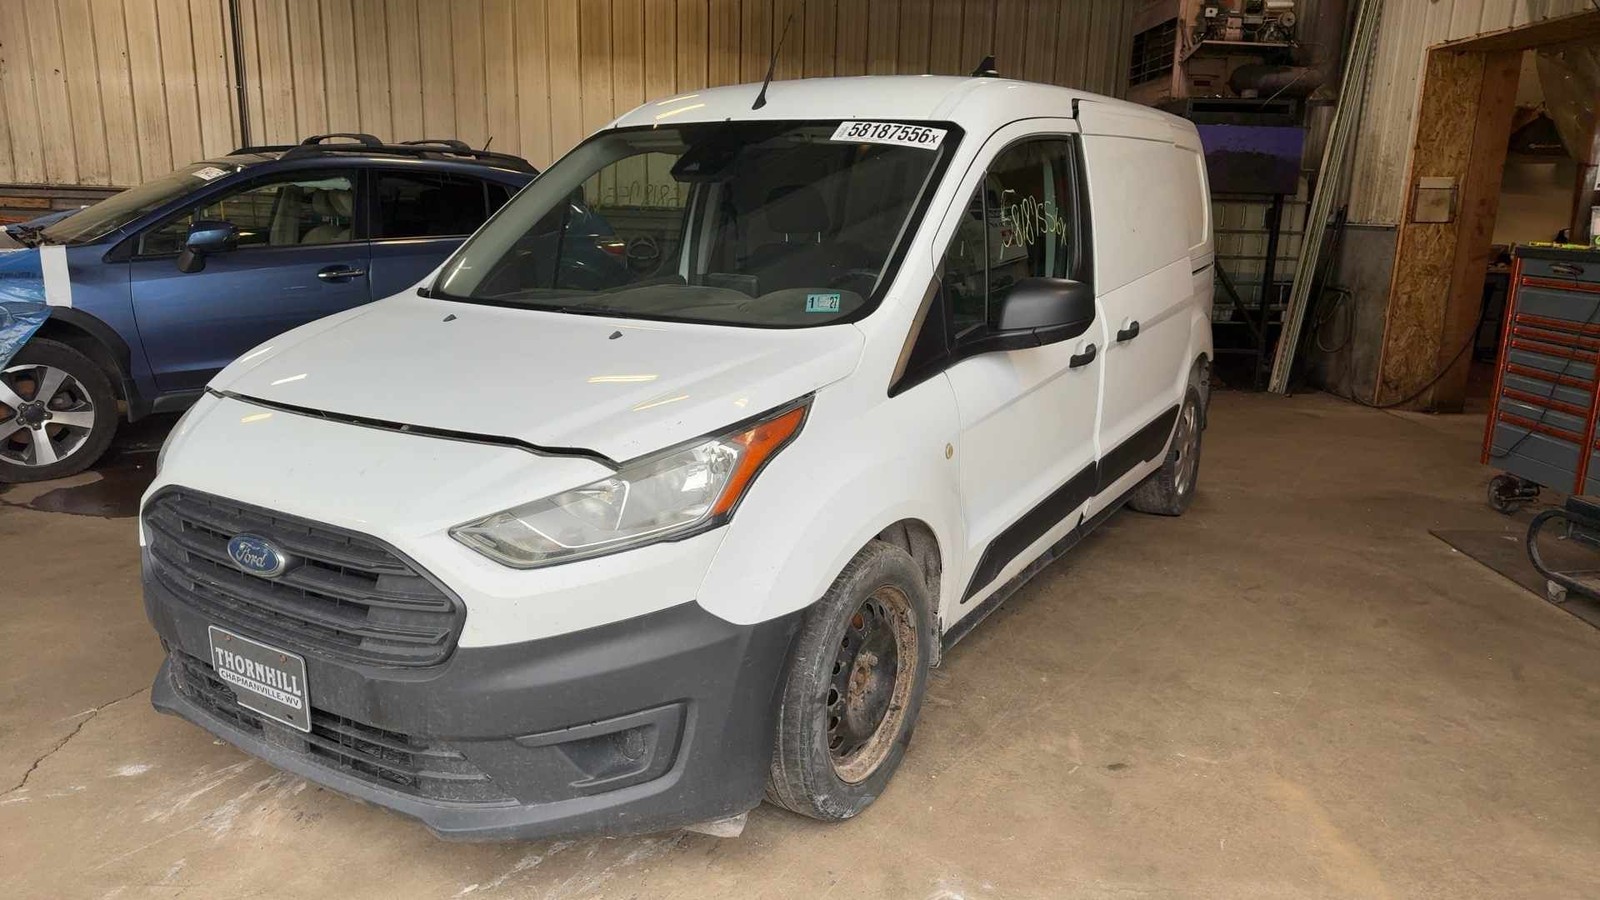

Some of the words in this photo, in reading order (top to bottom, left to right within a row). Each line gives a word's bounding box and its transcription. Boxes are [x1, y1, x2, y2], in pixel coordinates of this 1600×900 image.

[236, 542, 268, 567] Ford
[215, 647, 301, 697] THORNHILL
[285, 694, 299, 707] WV
